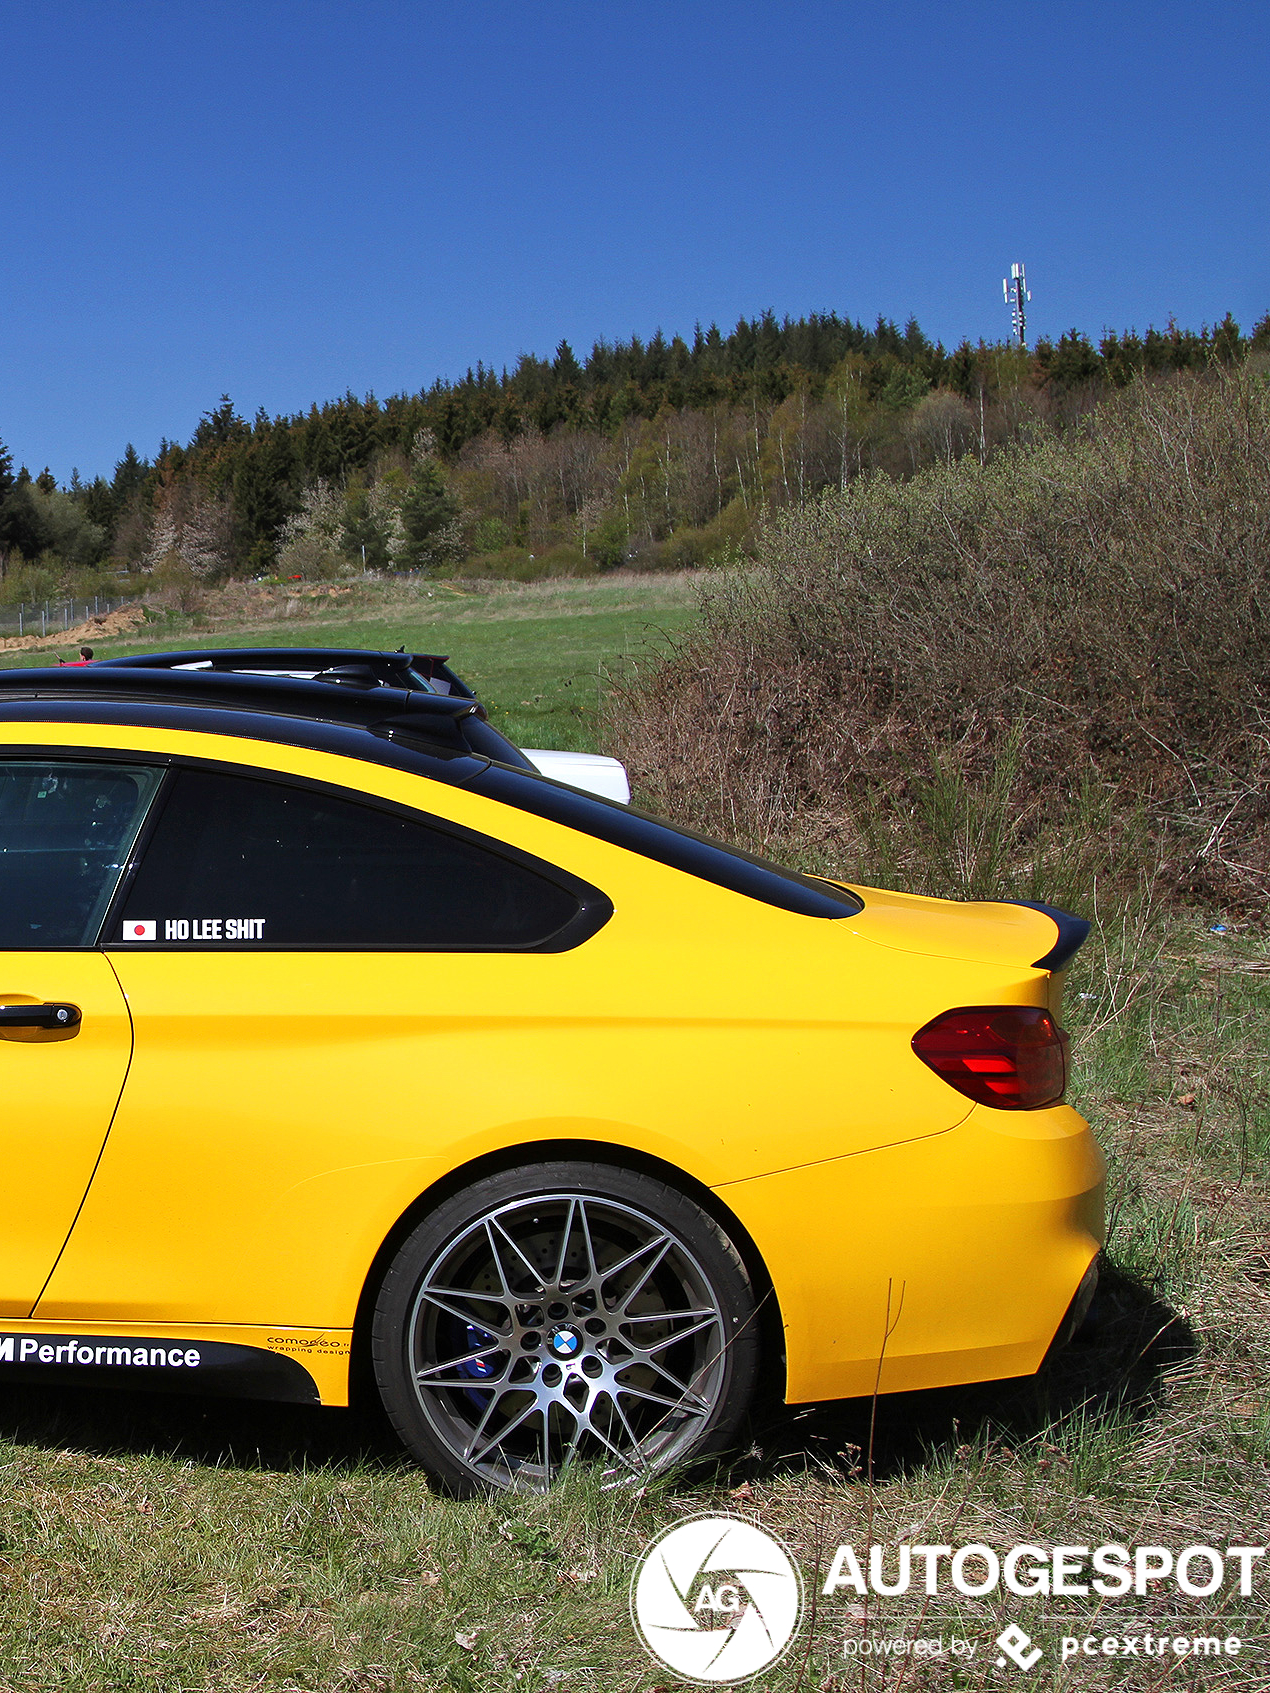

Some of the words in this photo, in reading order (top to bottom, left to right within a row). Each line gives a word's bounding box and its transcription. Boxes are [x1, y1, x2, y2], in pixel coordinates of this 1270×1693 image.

[165, 919, 189, 940] HO
[193, 919, 223, 940] LEE
[226, 918, 265, 940] SHIT
[20, 1338, 201, 1367] Performance
[267, 1345, 313, 1354] wrapping
